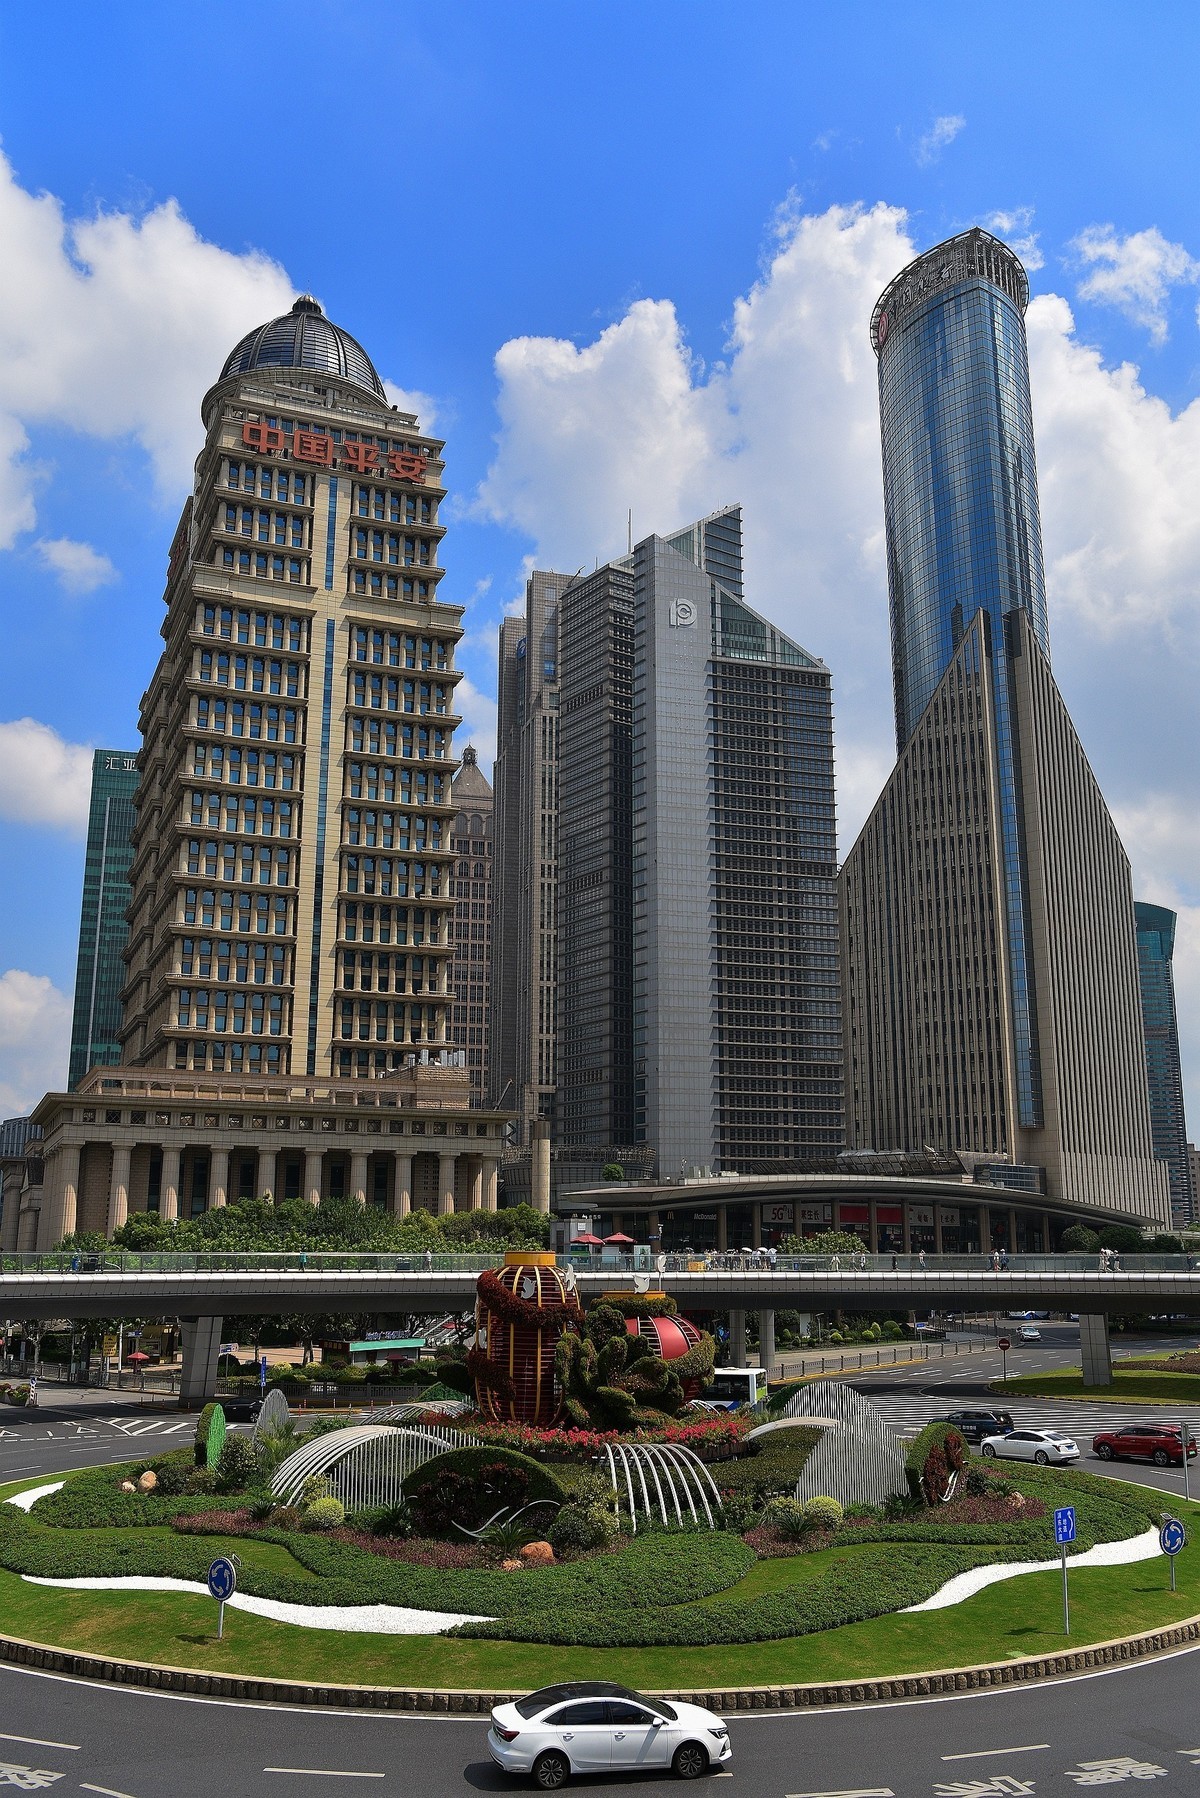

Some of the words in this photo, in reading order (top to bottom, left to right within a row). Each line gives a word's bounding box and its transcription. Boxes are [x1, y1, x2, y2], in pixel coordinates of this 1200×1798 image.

[242, 421, 428, 484] 中国平安
[105, 756, 138, 771] 汇亚
